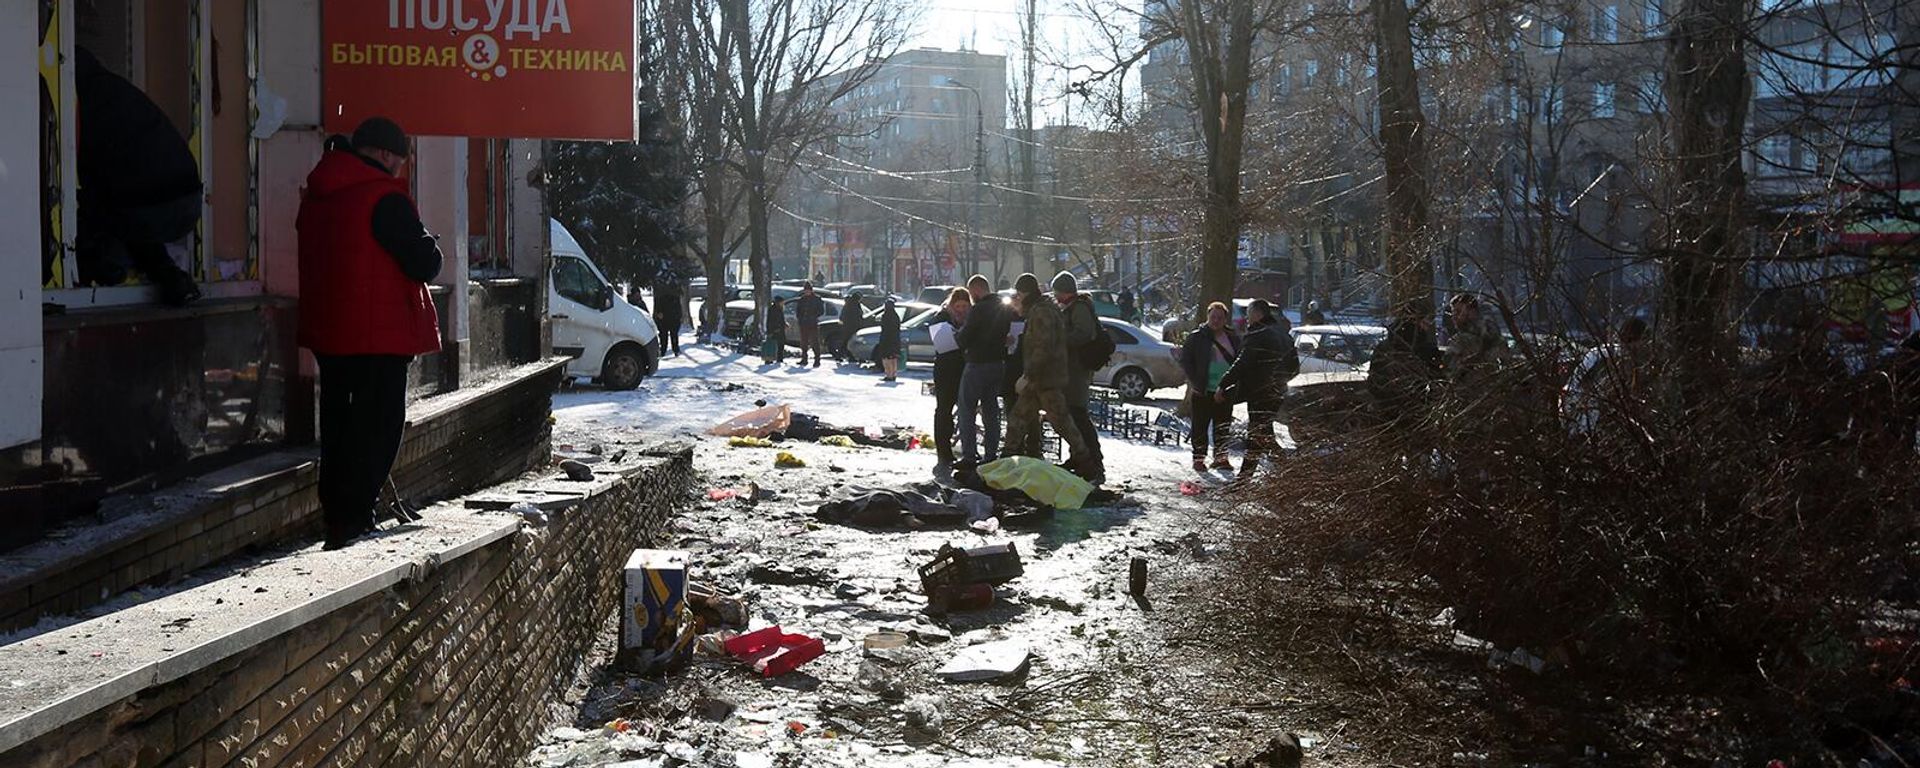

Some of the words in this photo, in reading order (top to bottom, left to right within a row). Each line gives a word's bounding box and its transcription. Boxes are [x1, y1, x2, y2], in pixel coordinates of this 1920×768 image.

[332, 43, 457, 67] БЫТОВАЯ
[471, 39, 490, 63] &
[509, 48, 627, 72] ТЕХНИКА
